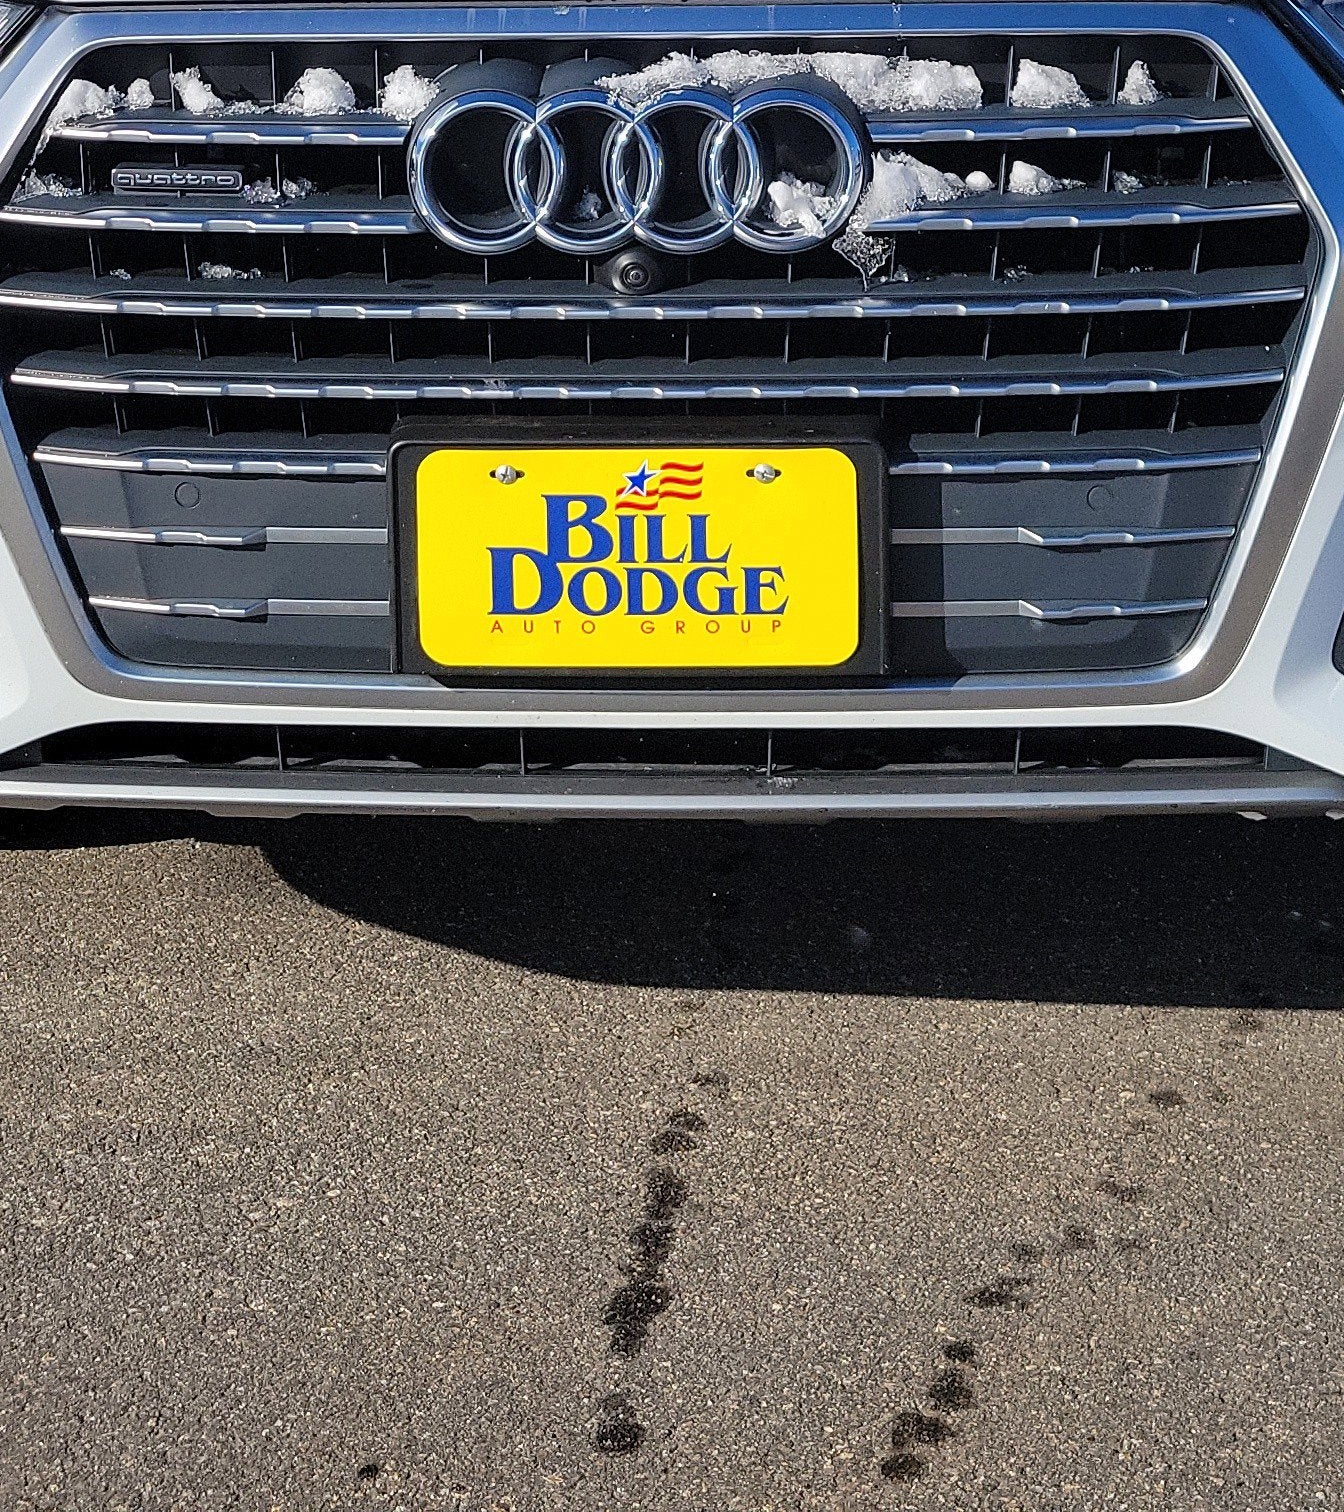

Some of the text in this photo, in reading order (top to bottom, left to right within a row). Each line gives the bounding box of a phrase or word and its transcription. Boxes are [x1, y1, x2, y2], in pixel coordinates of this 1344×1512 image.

[117, 172, 235, 186] quattro
[541, 494, 732, 563] BILL
[486, 547, 790, 616] DODGE
[490, 619, 782, 634] AUTO GROUP
